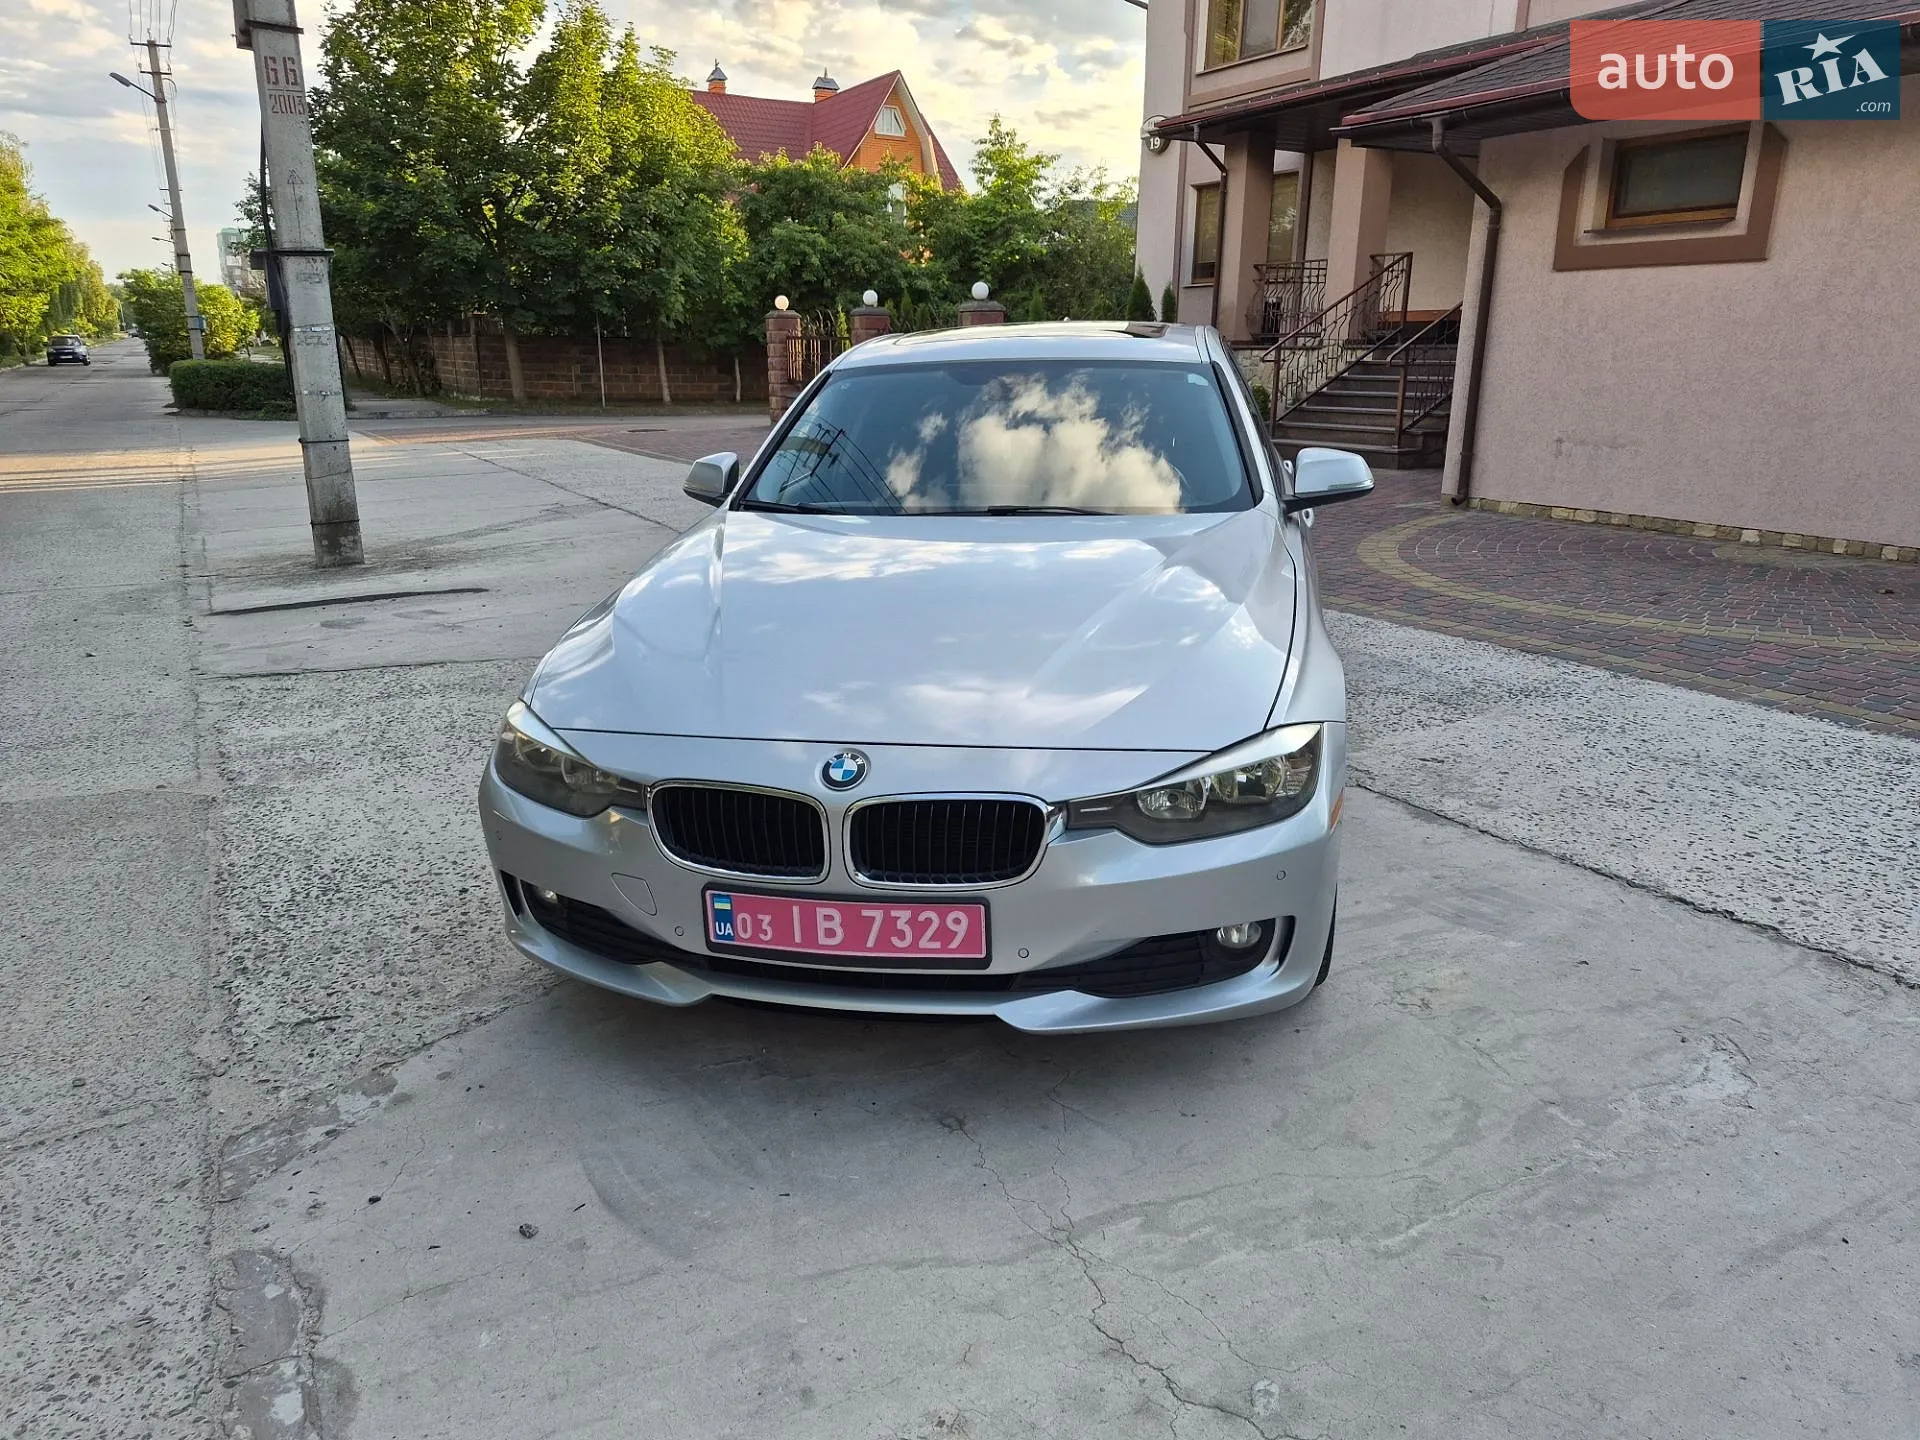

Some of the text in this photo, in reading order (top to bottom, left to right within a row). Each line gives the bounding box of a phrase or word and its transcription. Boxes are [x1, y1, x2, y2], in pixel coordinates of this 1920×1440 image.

[1150, 137, 1160, 149] 19
[715, 922, 734, 937] UA
[737, 905, 969, 949] 03 IB 7329
